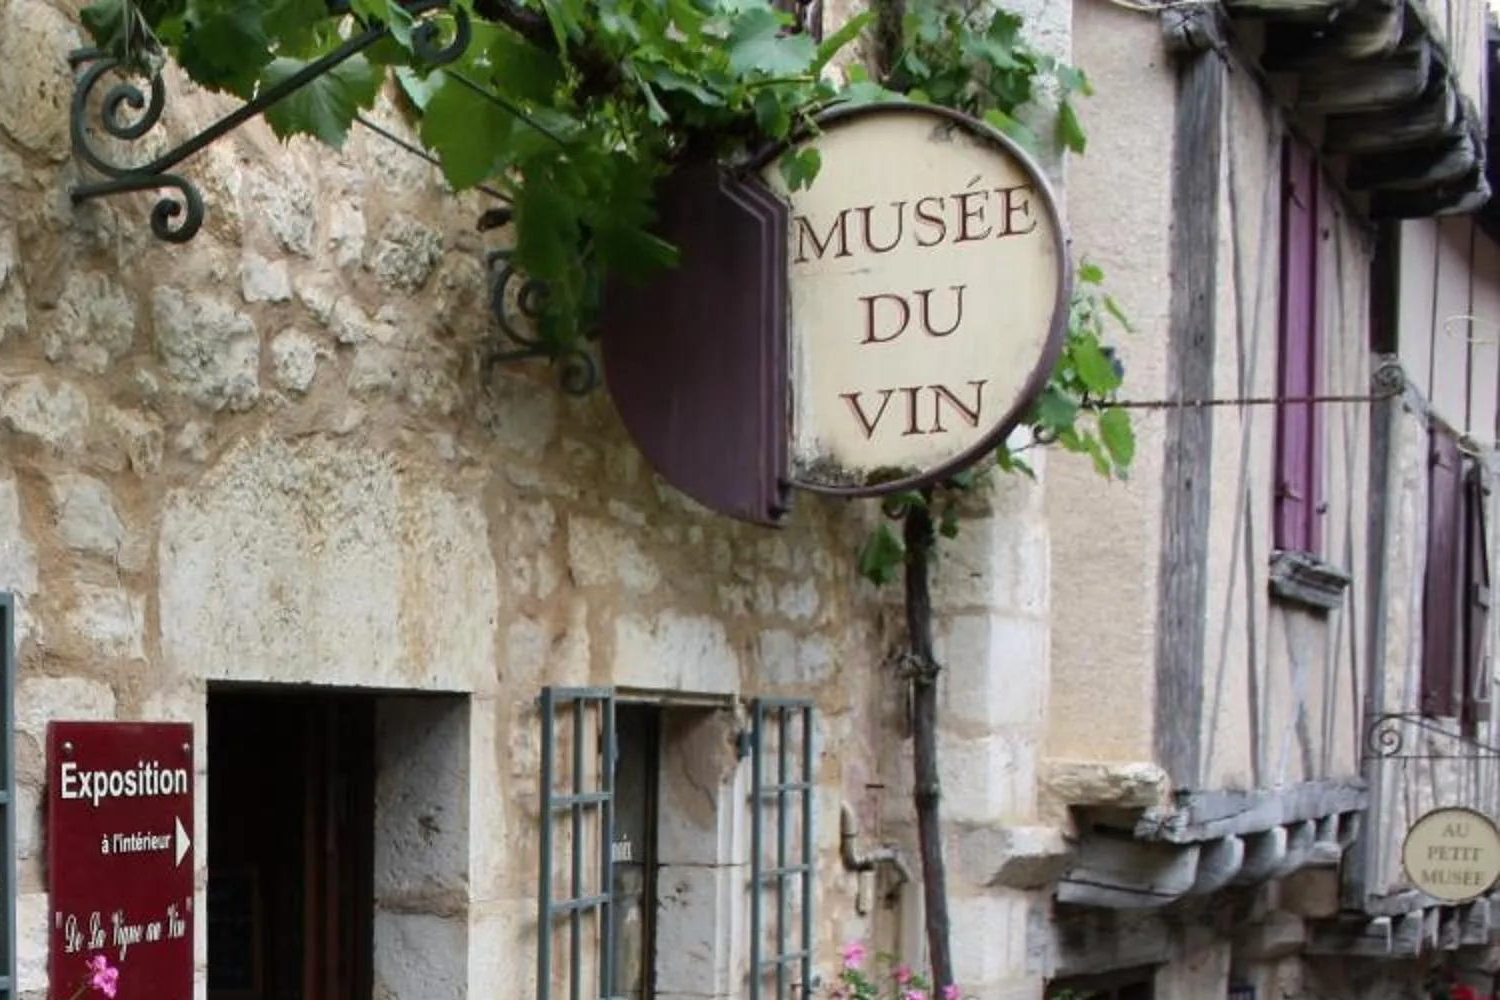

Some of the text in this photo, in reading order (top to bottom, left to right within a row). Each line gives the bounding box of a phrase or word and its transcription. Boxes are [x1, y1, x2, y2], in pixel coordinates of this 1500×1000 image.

[792, 175, 1038, 264] MUSÉE
[858, 285, 968, 345] DU
[838, 379, 988, 441] VIN
[60, 760, 189, 807] Exposition
[101, 832, 172, 854] à l'intérieur
[1427, 846, 1485, 862] PETIT
[1441, 822, 1470, 839] AU
